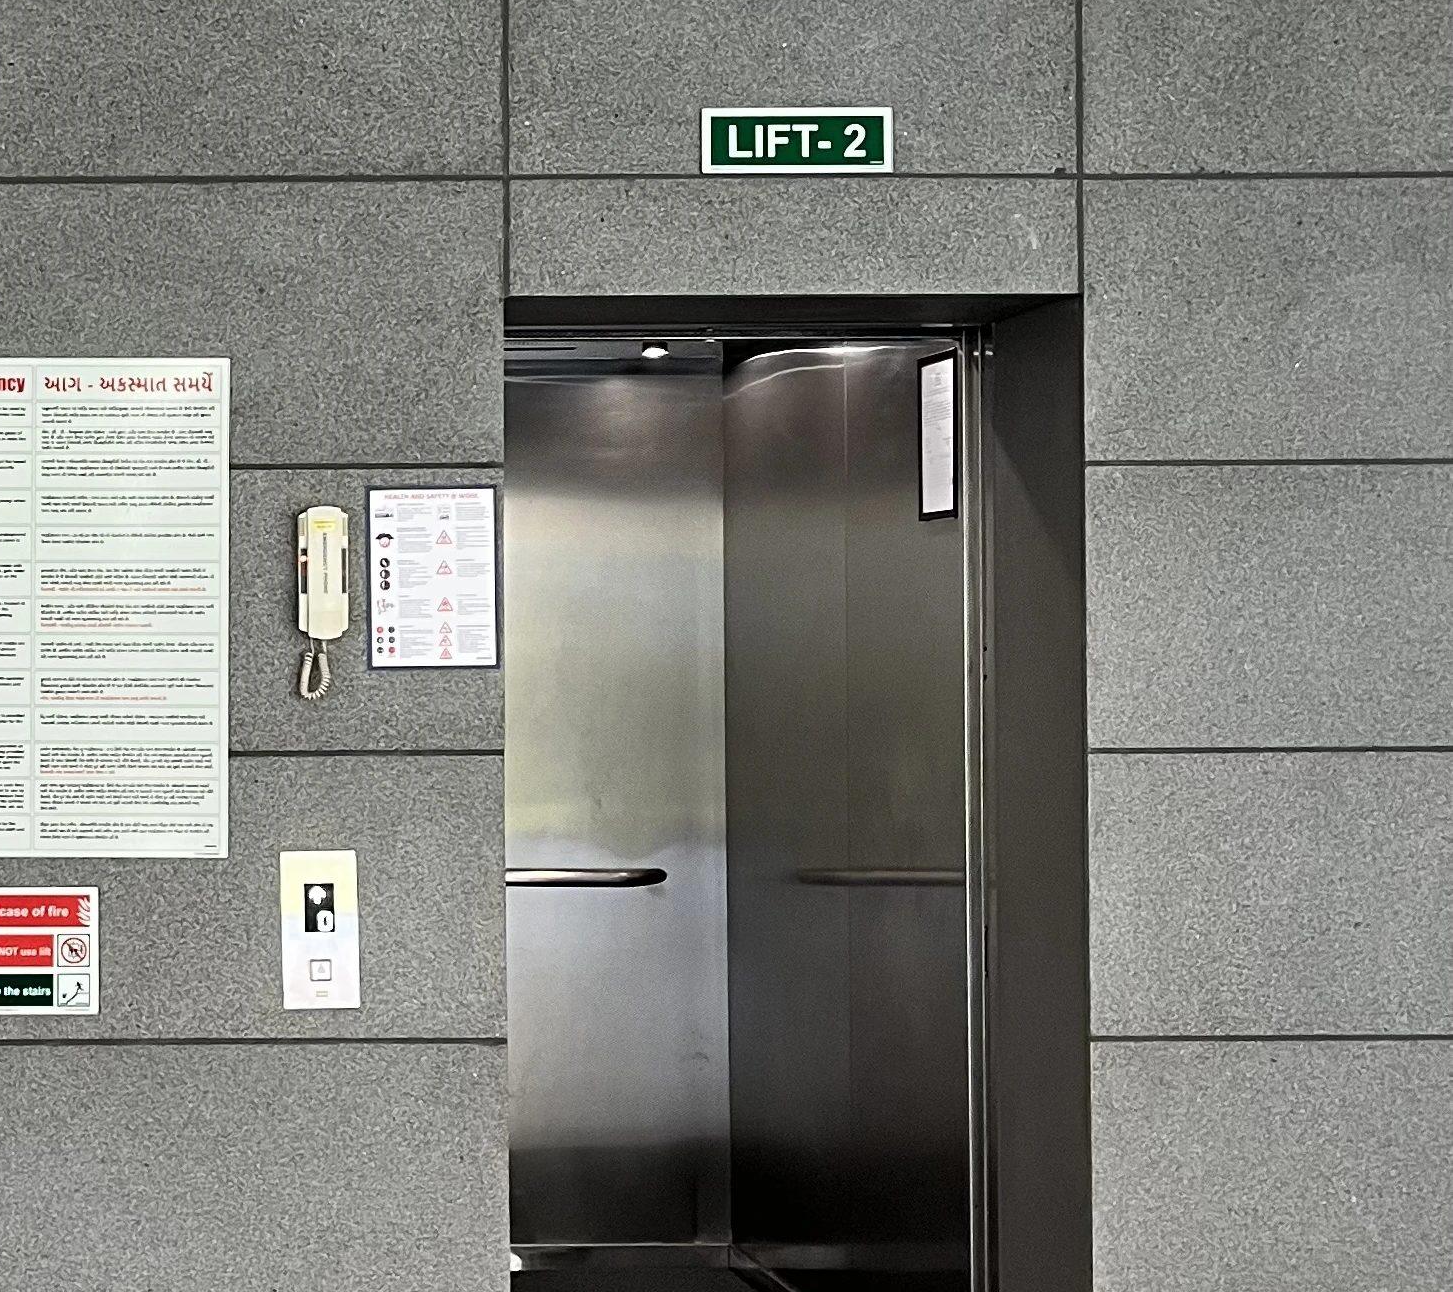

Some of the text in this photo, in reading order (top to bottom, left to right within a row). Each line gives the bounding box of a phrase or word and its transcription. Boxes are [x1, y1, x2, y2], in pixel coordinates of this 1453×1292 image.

[728, 123, 867, 158] LIFT- 2
[44, 376, 82, 392] આગ
[32, 905, 46, 917] of
[48, 905, 69, 917] fire
[20, 948, 37, 956] use
[3, 986, 21, 996] the
[22, 986, 52, 996] stairs
